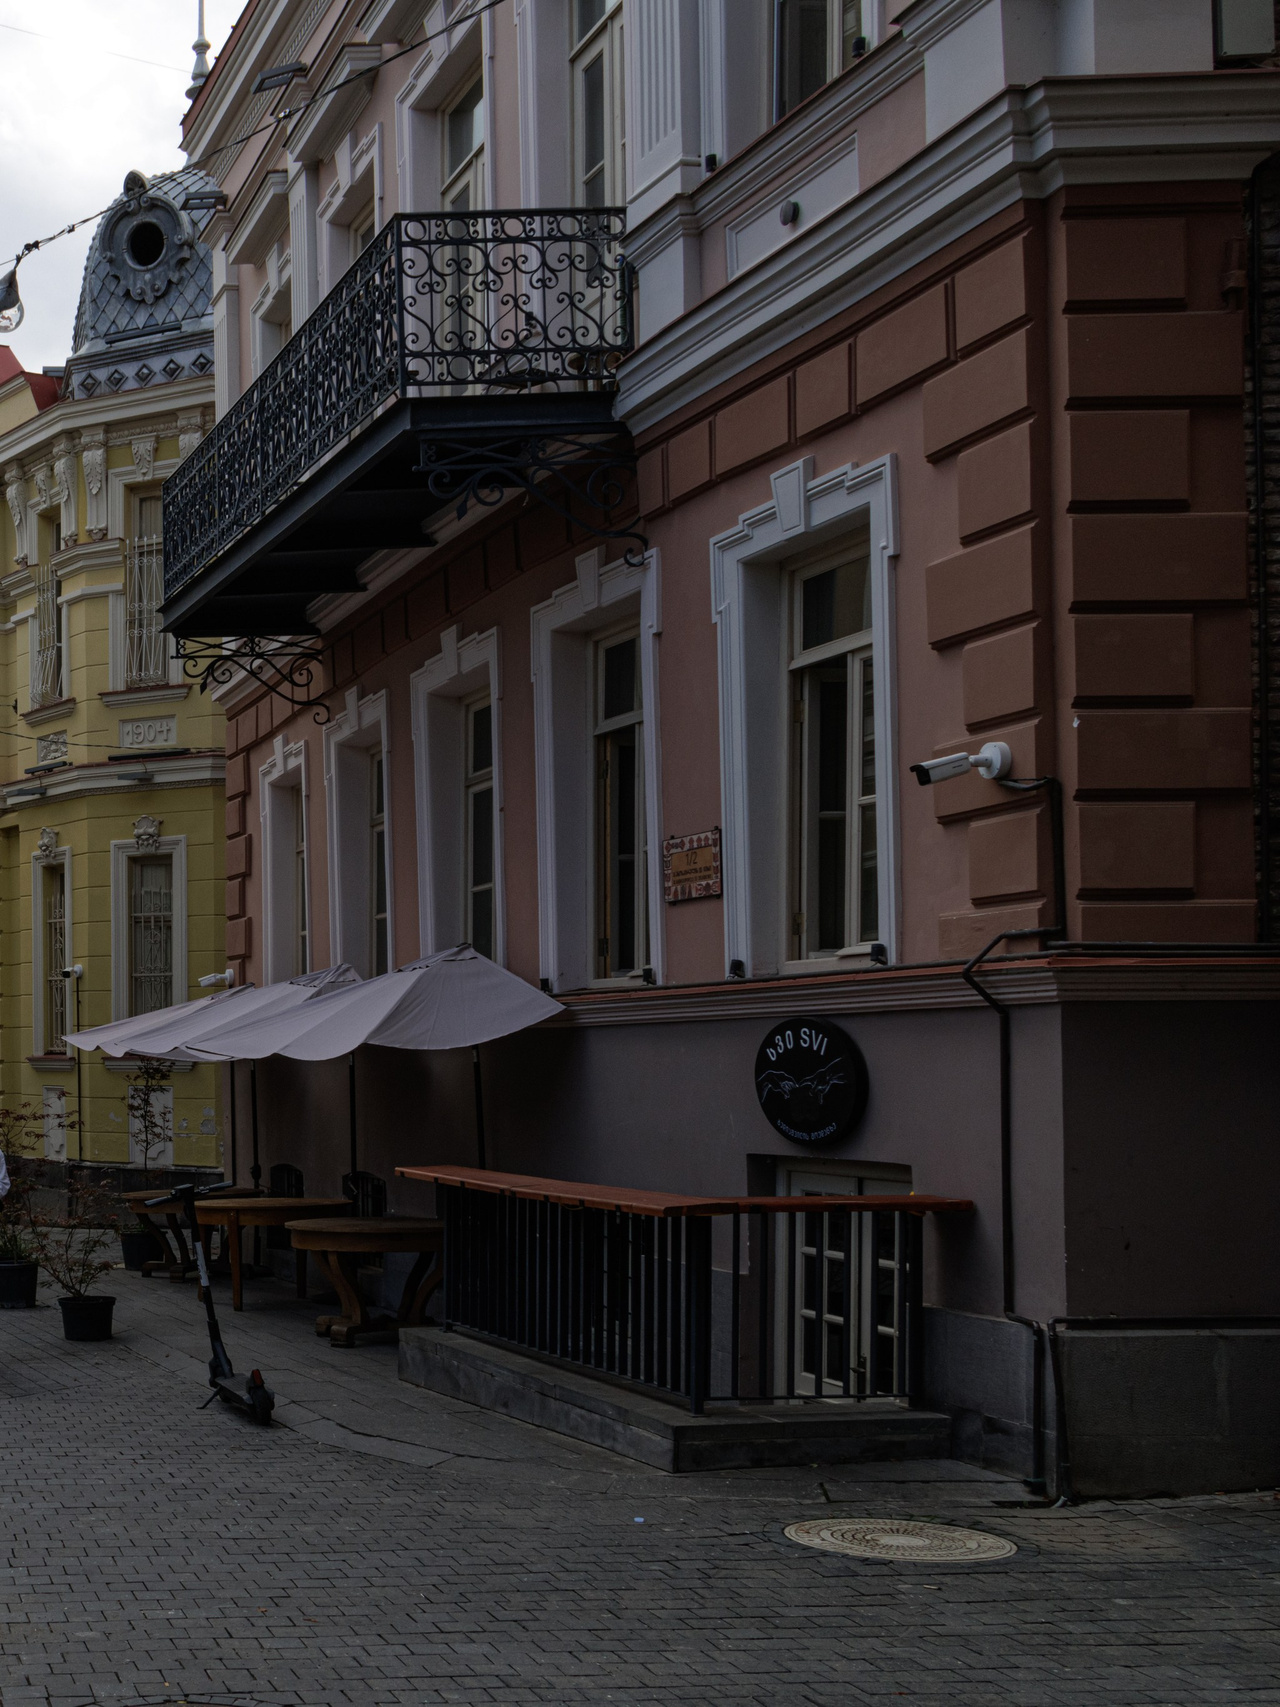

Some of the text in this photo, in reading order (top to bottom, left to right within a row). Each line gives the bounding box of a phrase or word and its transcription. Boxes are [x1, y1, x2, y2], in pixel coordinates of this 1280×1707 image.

[125, 721, 171, 744] 1904
[686, 851, 698, 866] 1/2
[800, 1027, 828, 1056] SVI
